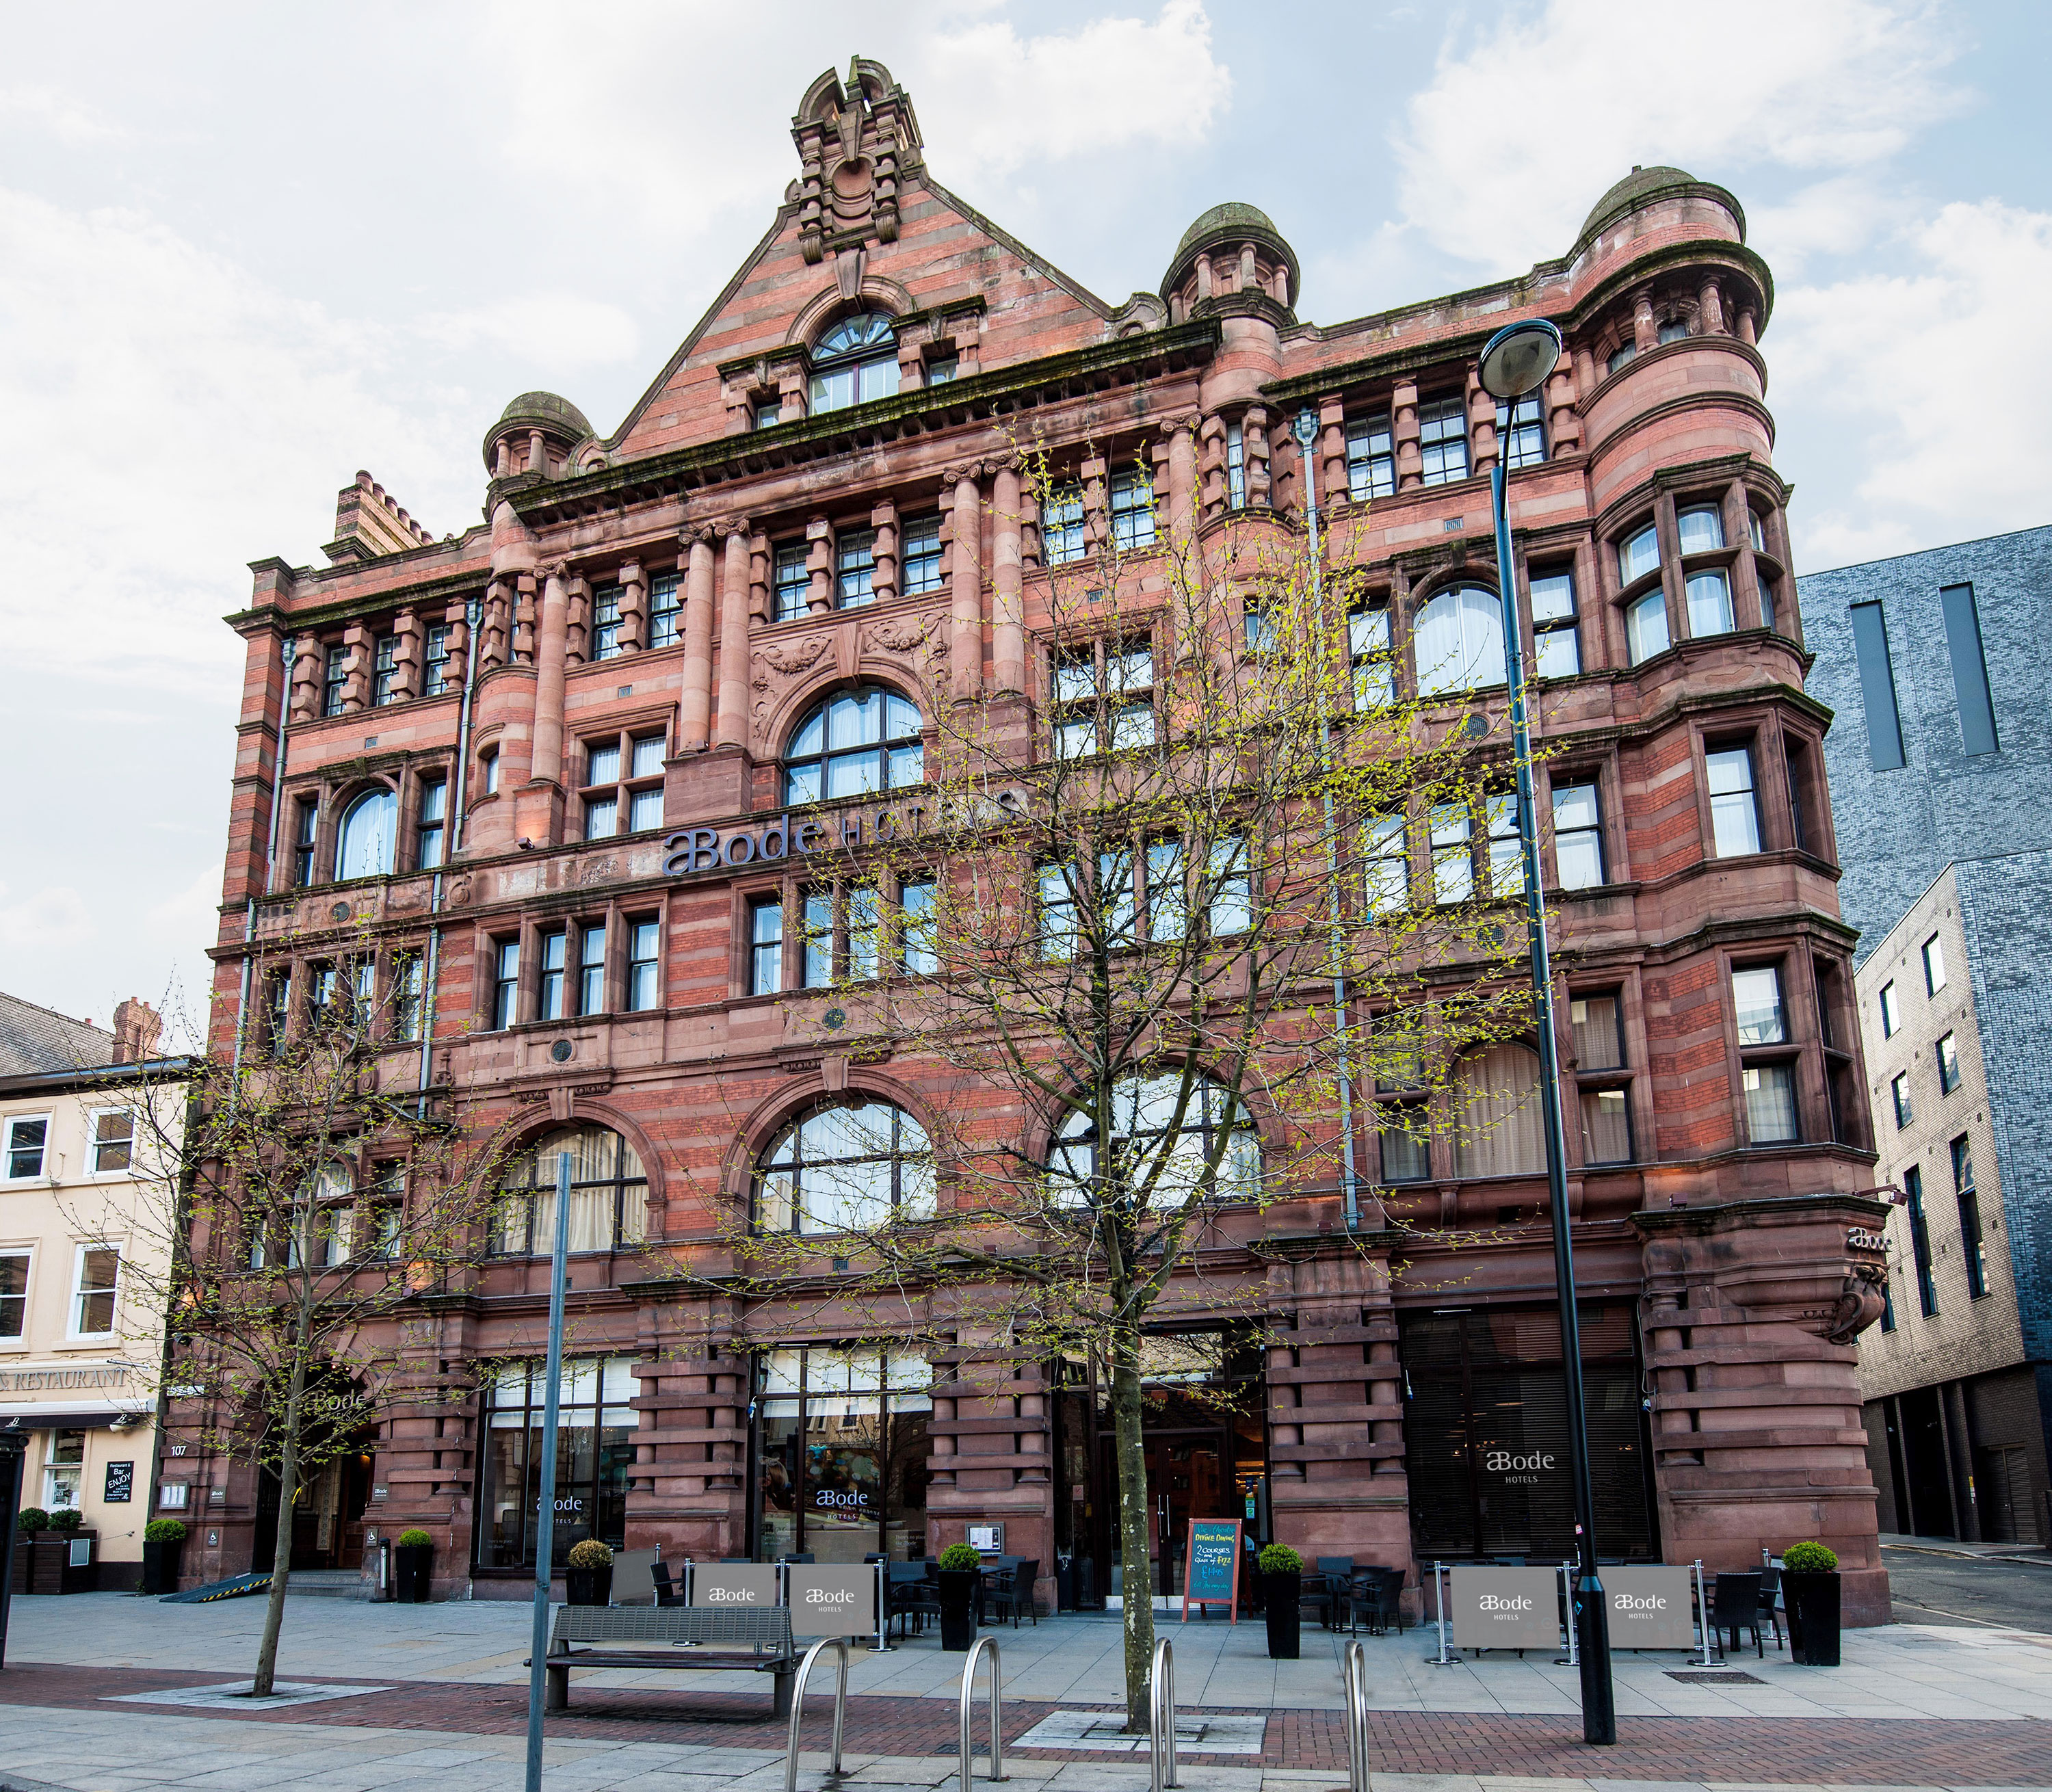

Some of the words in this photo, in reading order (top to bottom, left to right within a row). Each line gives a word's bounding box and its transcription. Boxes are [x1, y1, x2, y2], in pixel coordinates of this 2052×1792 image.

[14, 1369, 126, 1391] RESTAURANT
[171, 1445, 187, 1456] 107
[108, 1472, 131, 1488] ENJOY
[1505, 1475, 1538, 1484] HOTELS
[1197, 1544, 1203, 1556] 2
[1210, 1557, 1216, 1565] of
